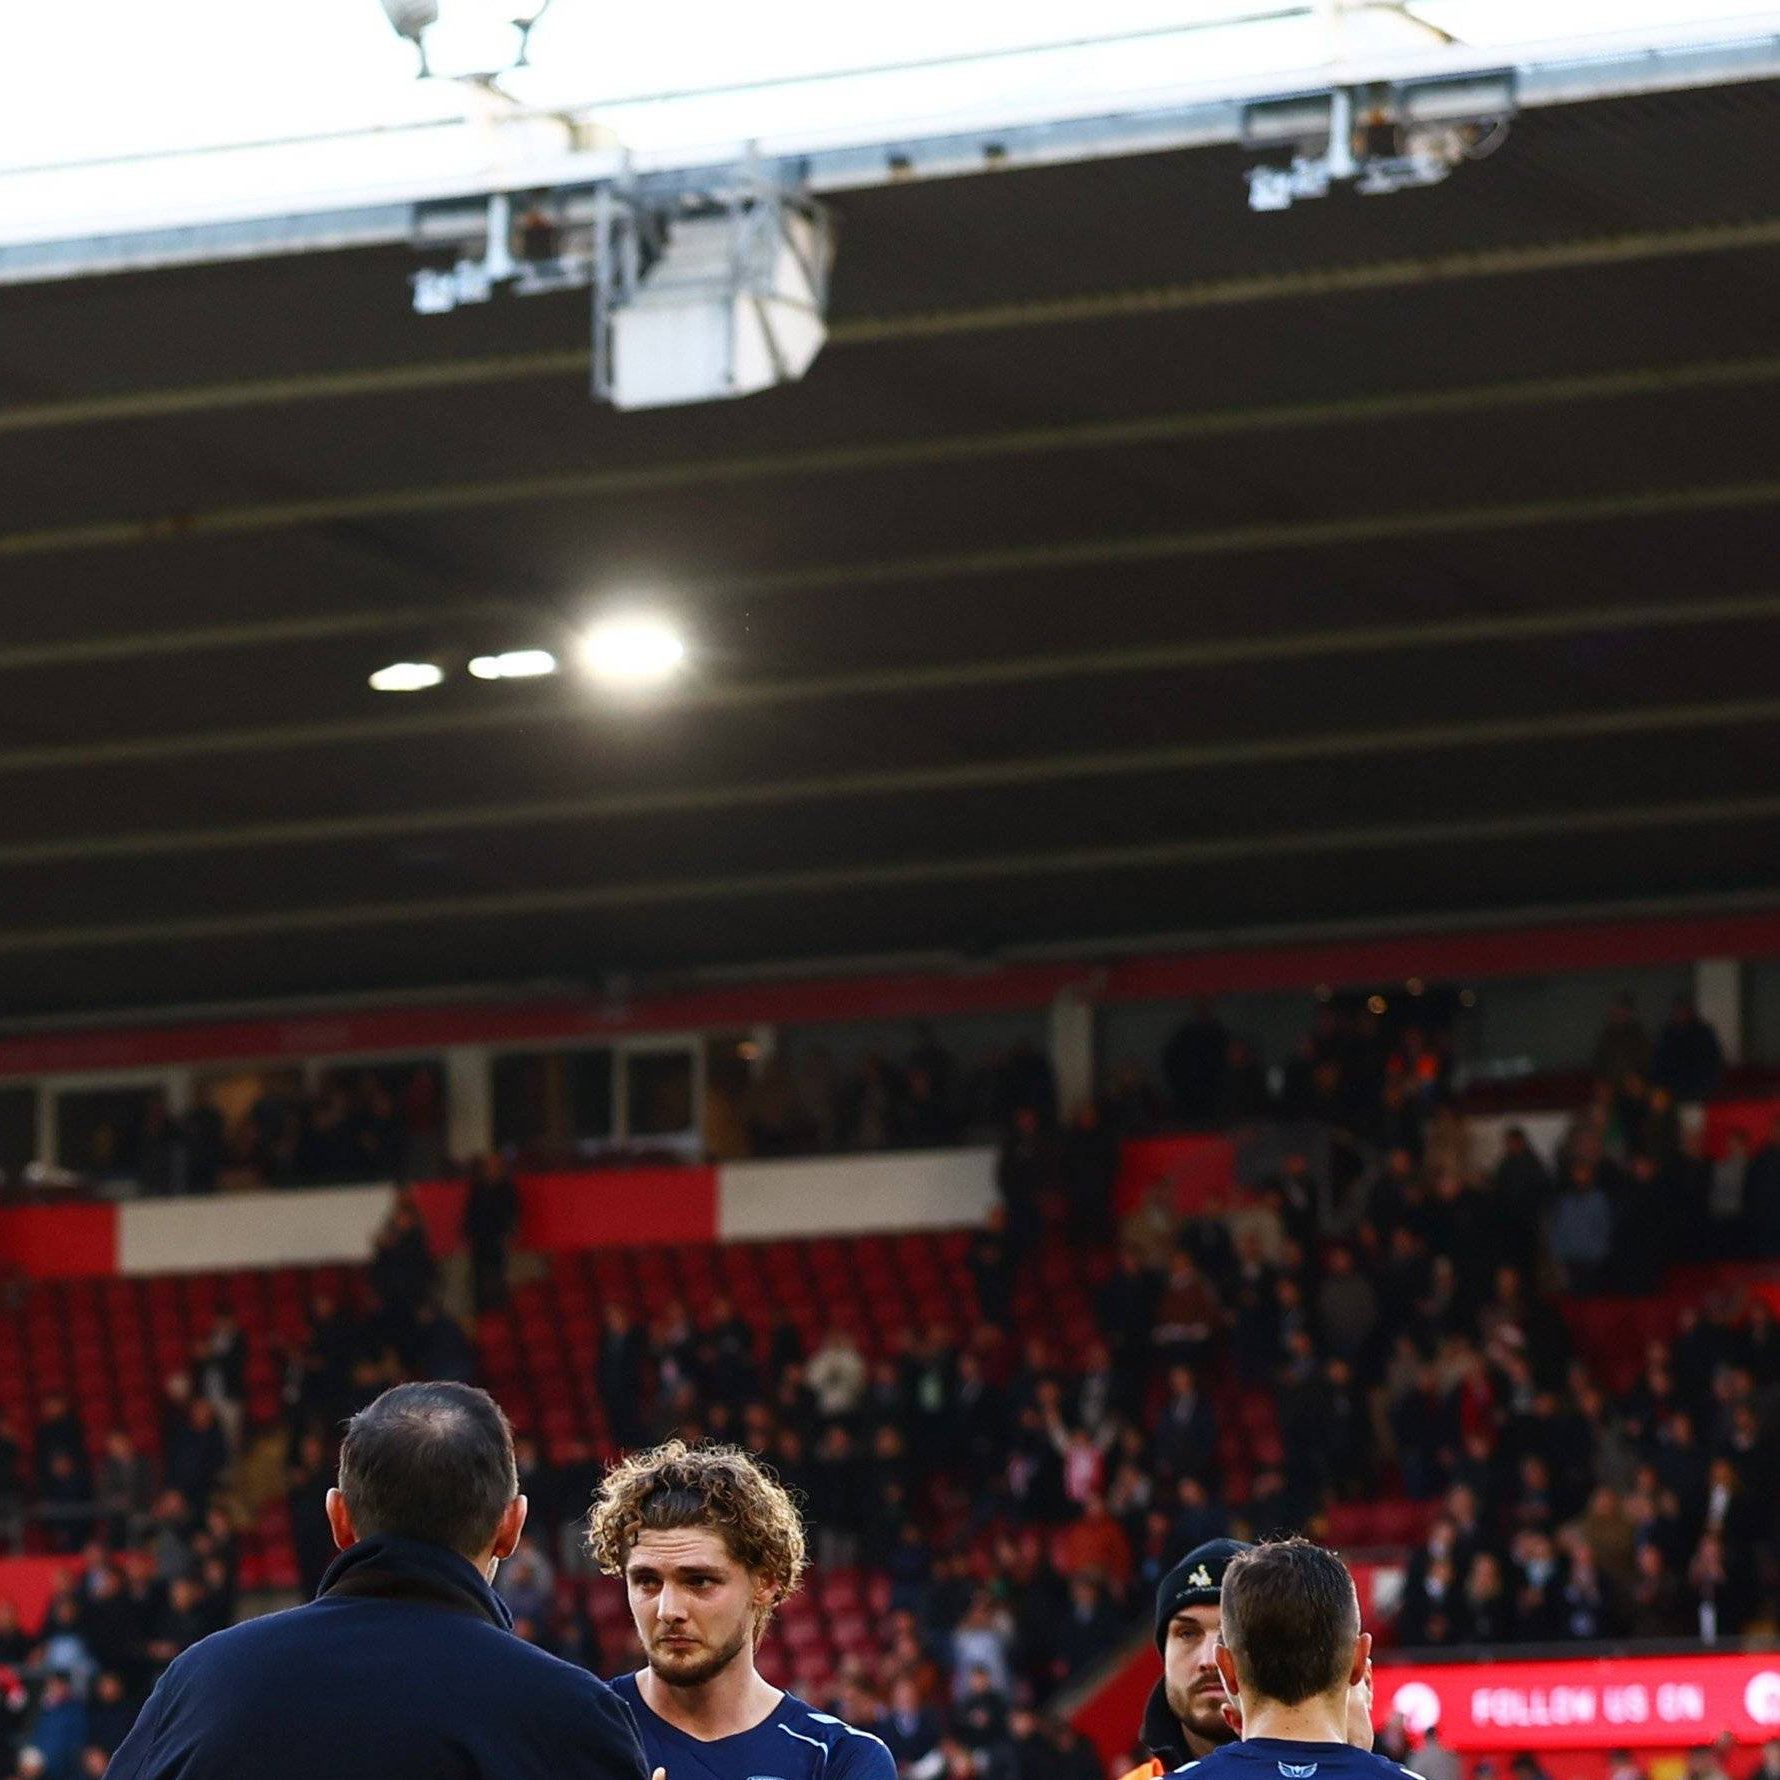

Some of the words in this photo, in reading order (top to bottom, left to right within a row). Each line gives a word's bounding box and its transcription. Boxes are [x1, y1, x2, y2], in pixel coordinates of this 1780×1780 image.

[1472, 1686, 1596, 1726] FOLLOW
[1604, 1684, 1648, 1723] US
[1657, 1682, 1704, 1722] ON
